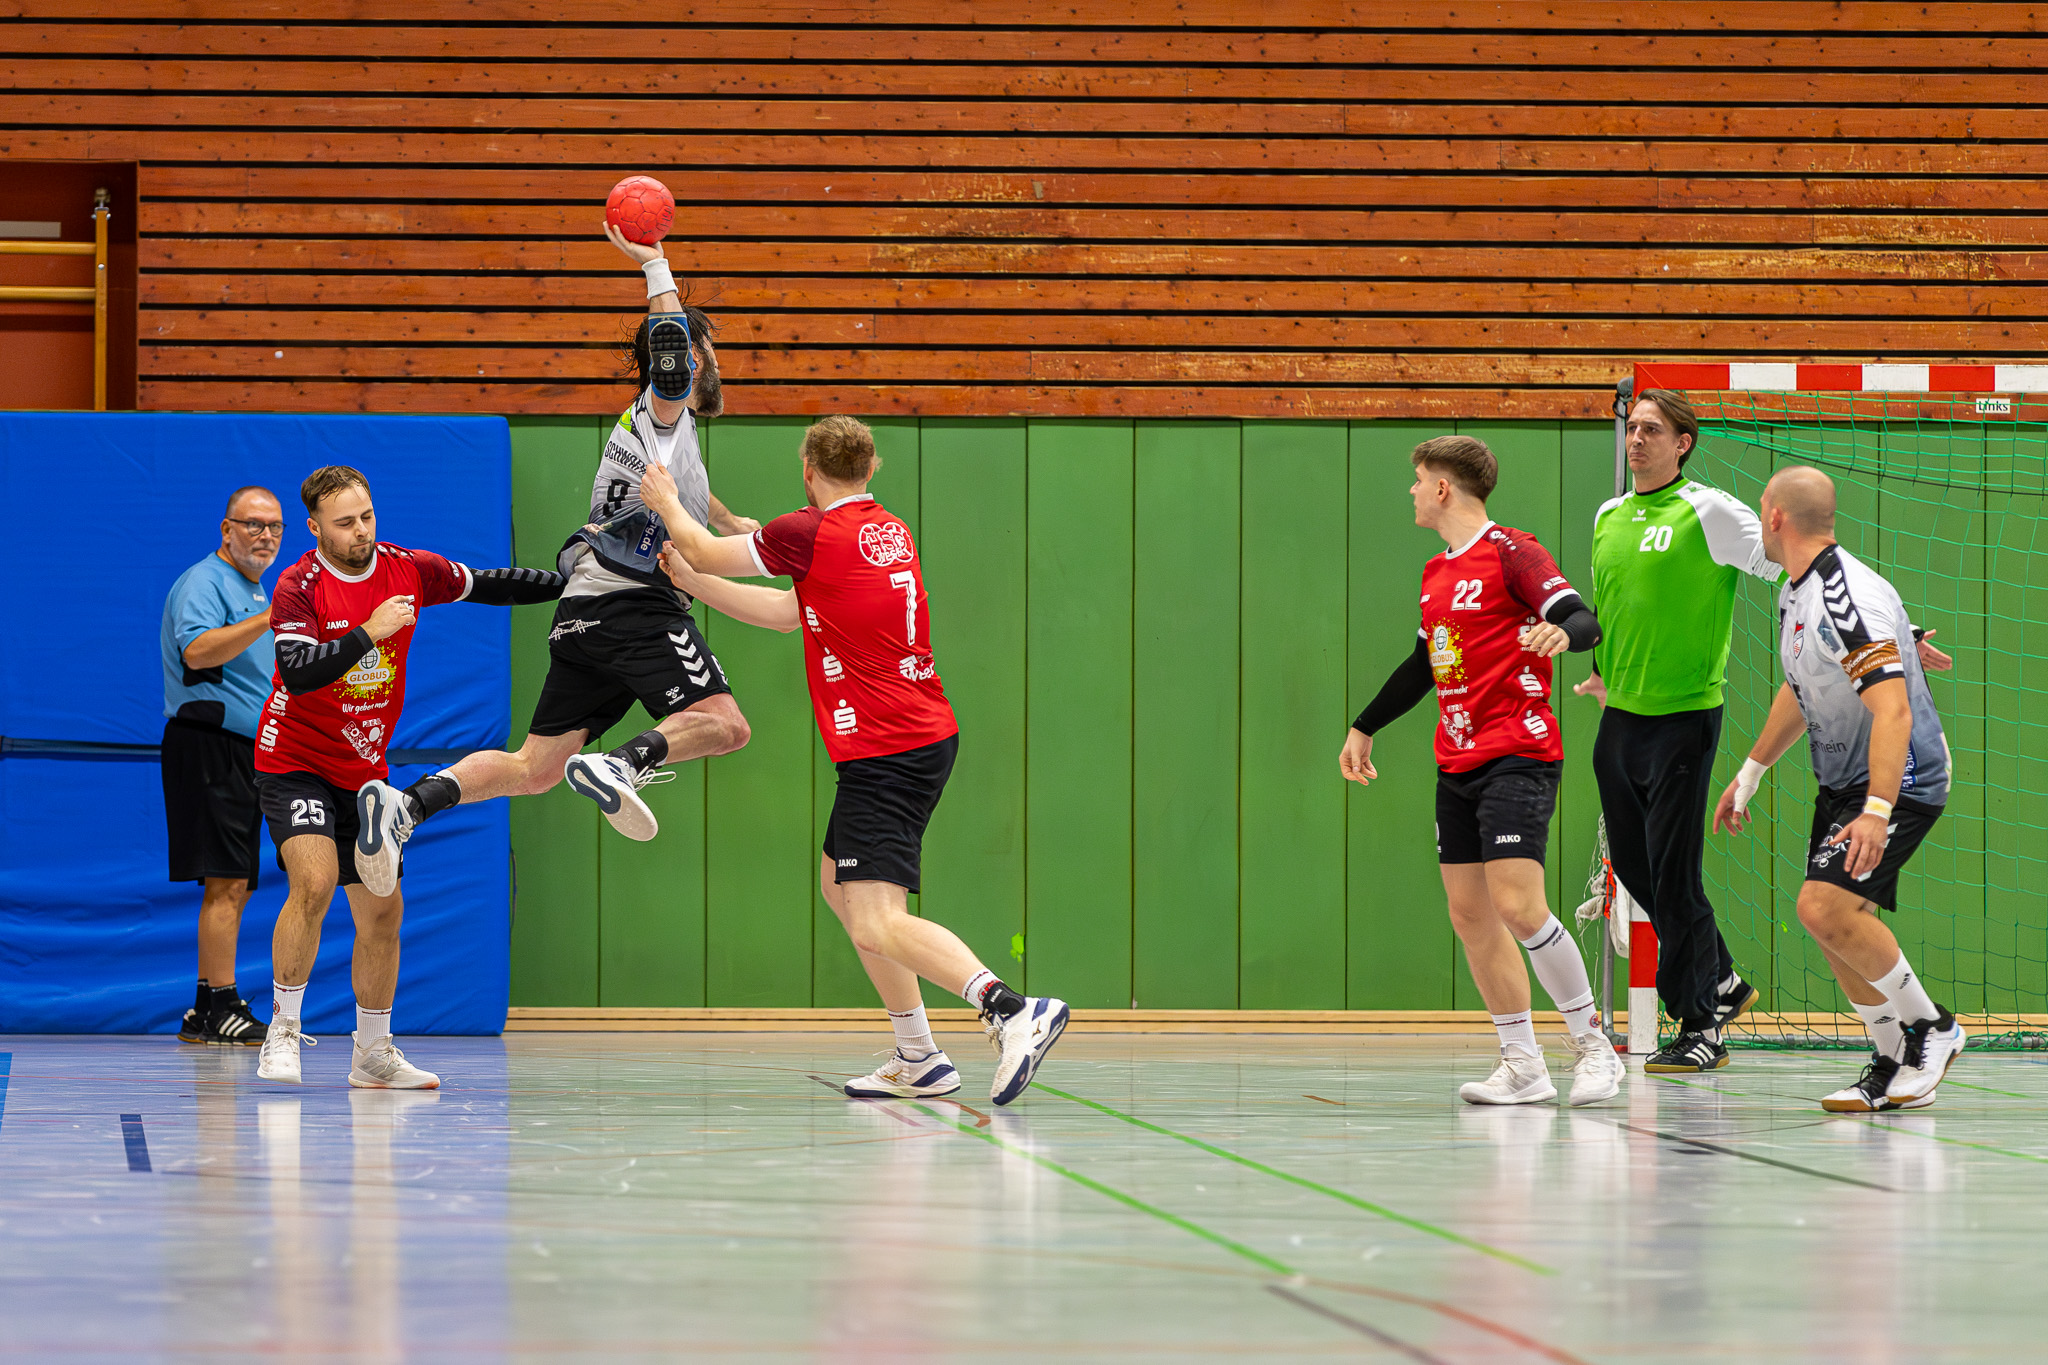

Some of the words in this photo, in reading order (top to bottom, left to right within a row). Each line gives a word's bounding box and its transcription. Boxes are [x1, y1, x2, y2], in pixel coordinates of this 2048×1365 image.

[1978, 400, 2008, 411] Links
[1639, 525, 1673, 552] 20
[1451, 579, 1482, 611] 22
[889, 570, 917, 646] 7
[326, 620, 349, 630] JAKO
[349, 670, 388, 682] GLOBUS
[290, 799, 326, 827] 25
[1495, 835, 1521, 844] JAKO
[838, 859, 858, 867] JAKO
